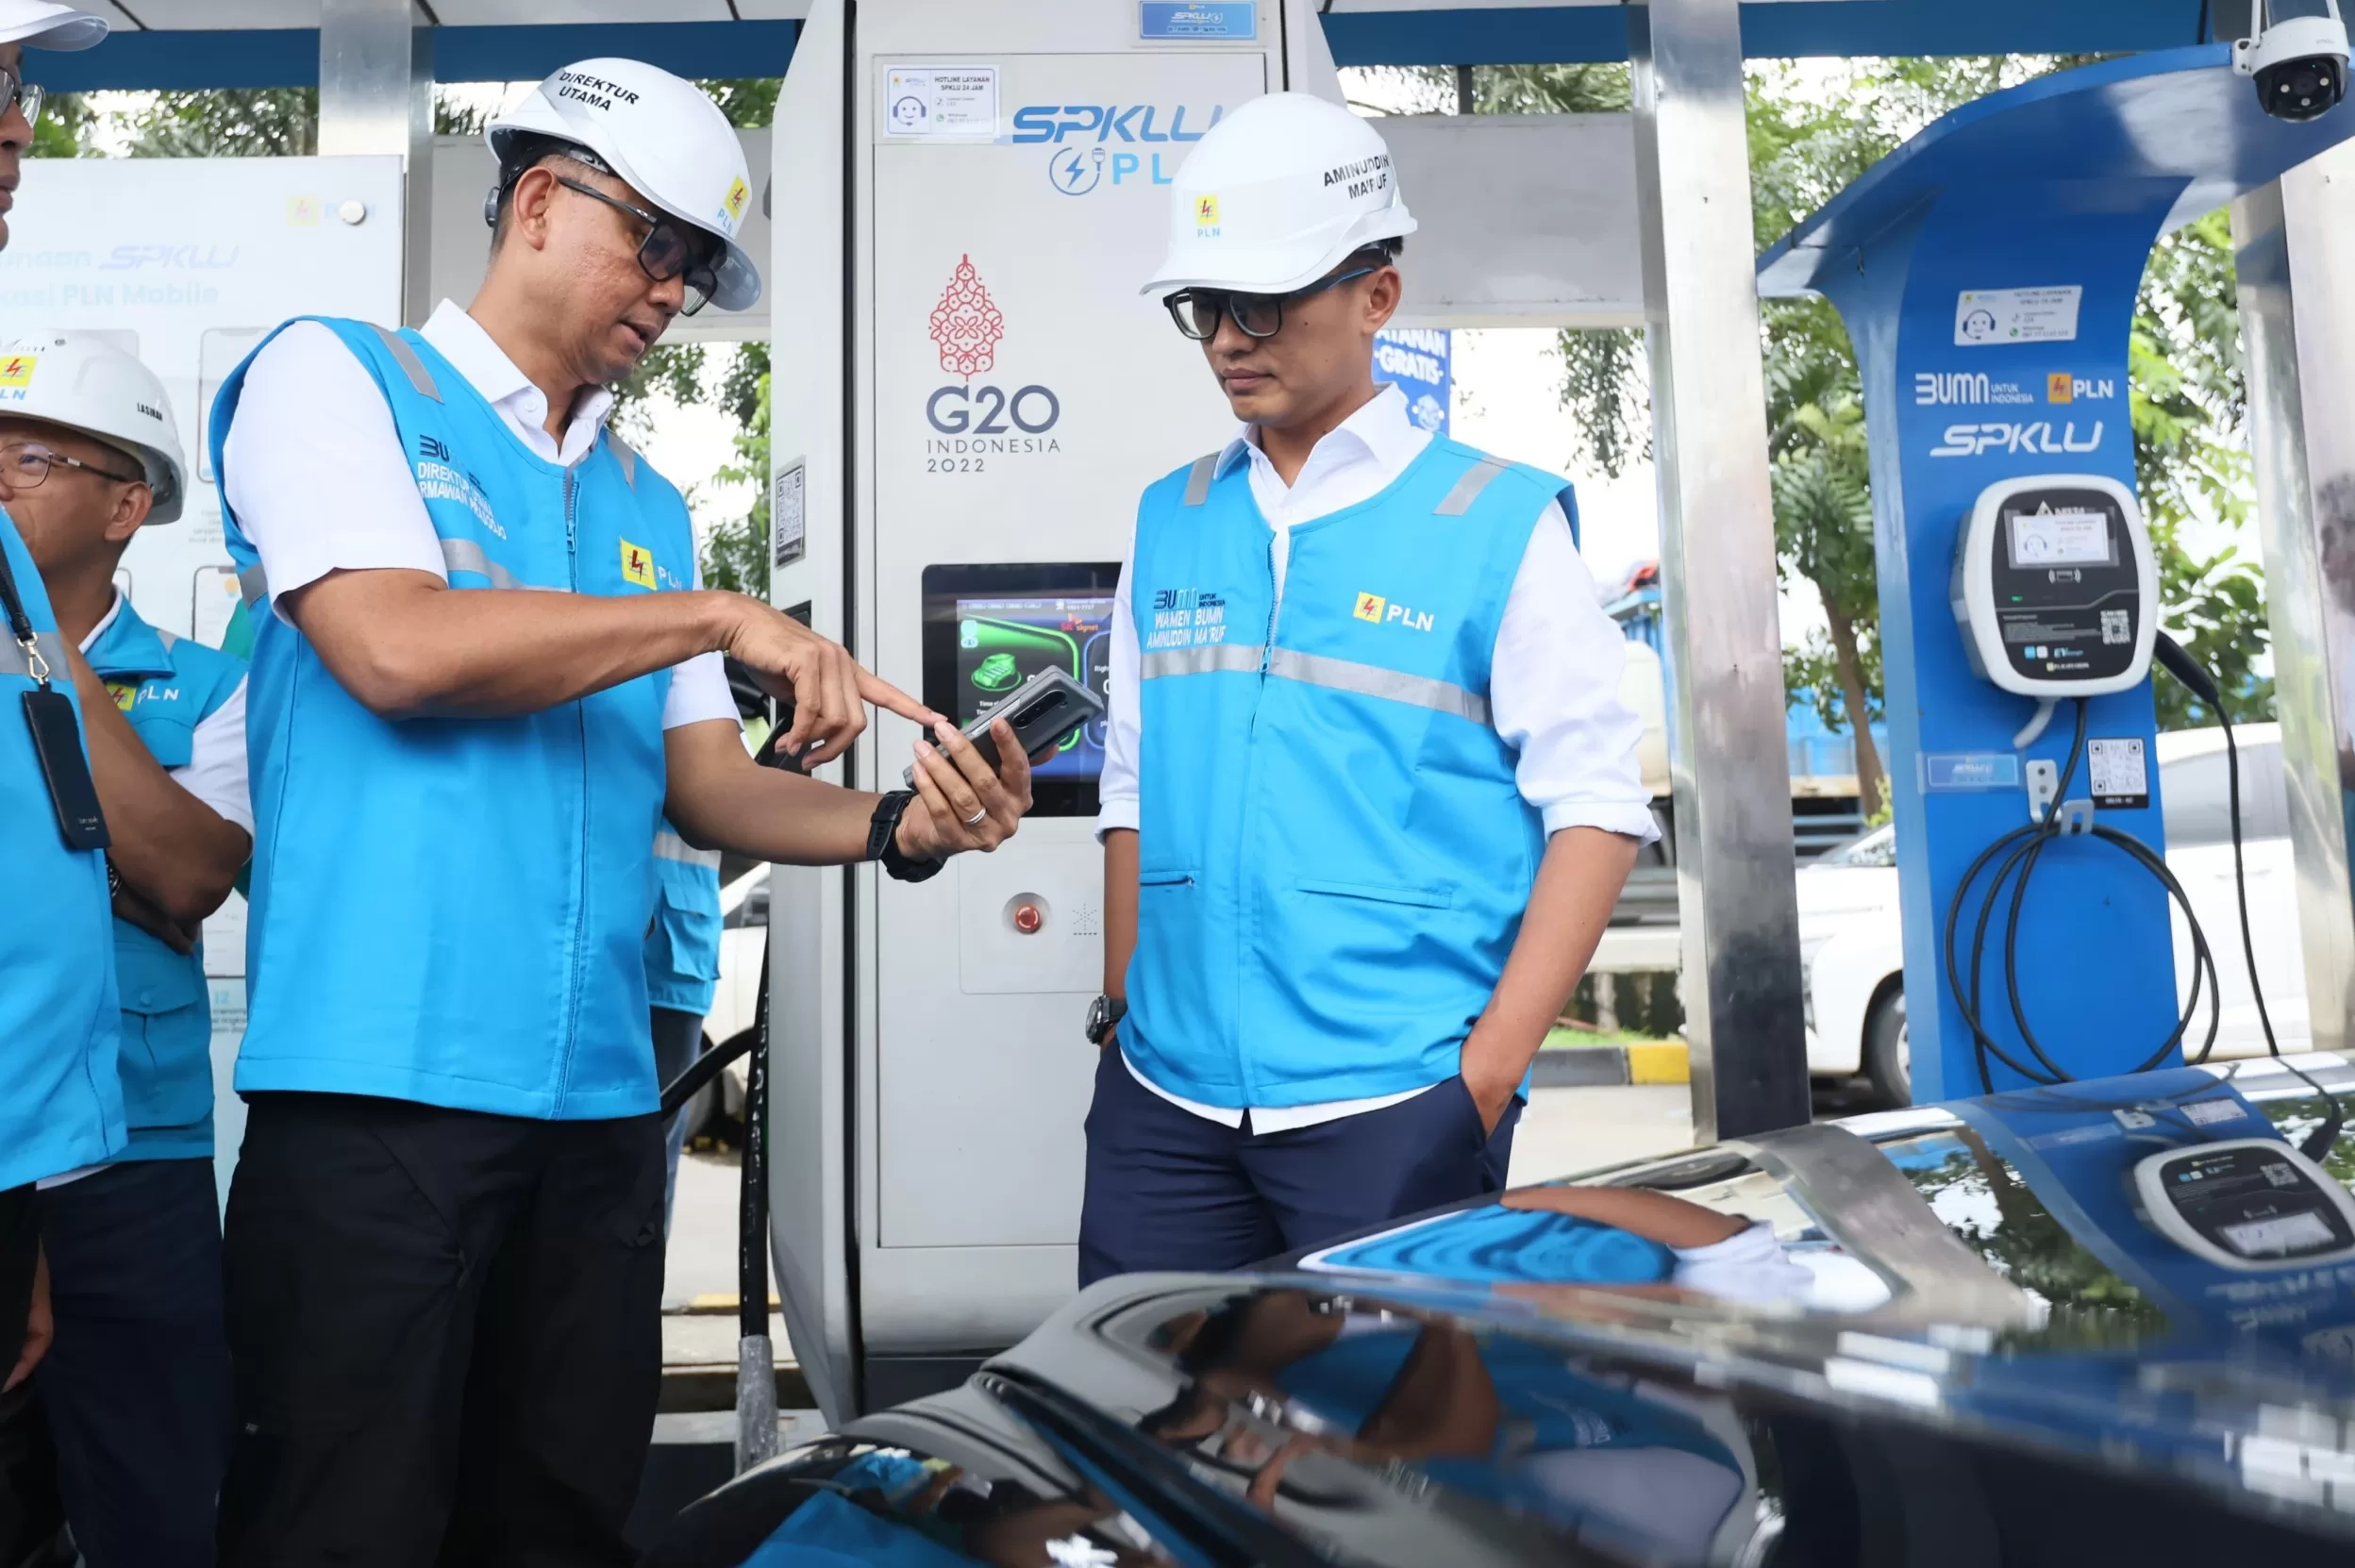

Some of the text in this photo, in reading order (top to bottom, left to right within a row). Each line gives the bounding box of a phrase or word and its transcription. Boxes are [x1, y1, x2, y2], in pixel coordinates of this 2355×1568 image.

[559, 72, 640, 105] DIREKTUR
[559, 86, 611, 111] UTAMA
[1111, 153, 1175, 185] PL
[1324, 155, 1390, 187] AMINUDDIN
[717, 208, 734, 236] PLN
[1197, 227, 1220, 238] PLN
[99, 244, 241, 270] SPKLU
[62, 285, 114, 307] PLN
[123, 282, 219, 307] Mobile
[0, 388, 26, 400] LN
[1915, 372, 1990, 405] BUMN
[1991, 383, 2019, 392] UNTUK
[1991, 392, 2034, 404] INDONESIA
[2073, 378, 2114, 399] PLN
[926, 384, 1060, 435] G20
[927, 438, 1061, 454] INDONESIA
[1929, 421, 2104, 458] SPKLU
[418, 461, 470, 492] DIREKTUR
[927, 458, 985, 473] 2022
[418, 480, 469, 507] RMAWAN
[1154, 588, 1198, 609] BUMN
[1199, 599, 1226, 608] INDONESIA
[1155, 607, 1224, 629] WAMEN BUMN
[1386, 604, 1434, 632] PLN
[1146, 628, 1192, 650] AMINUDDIN
[138, 685, 179, 706] PLN
